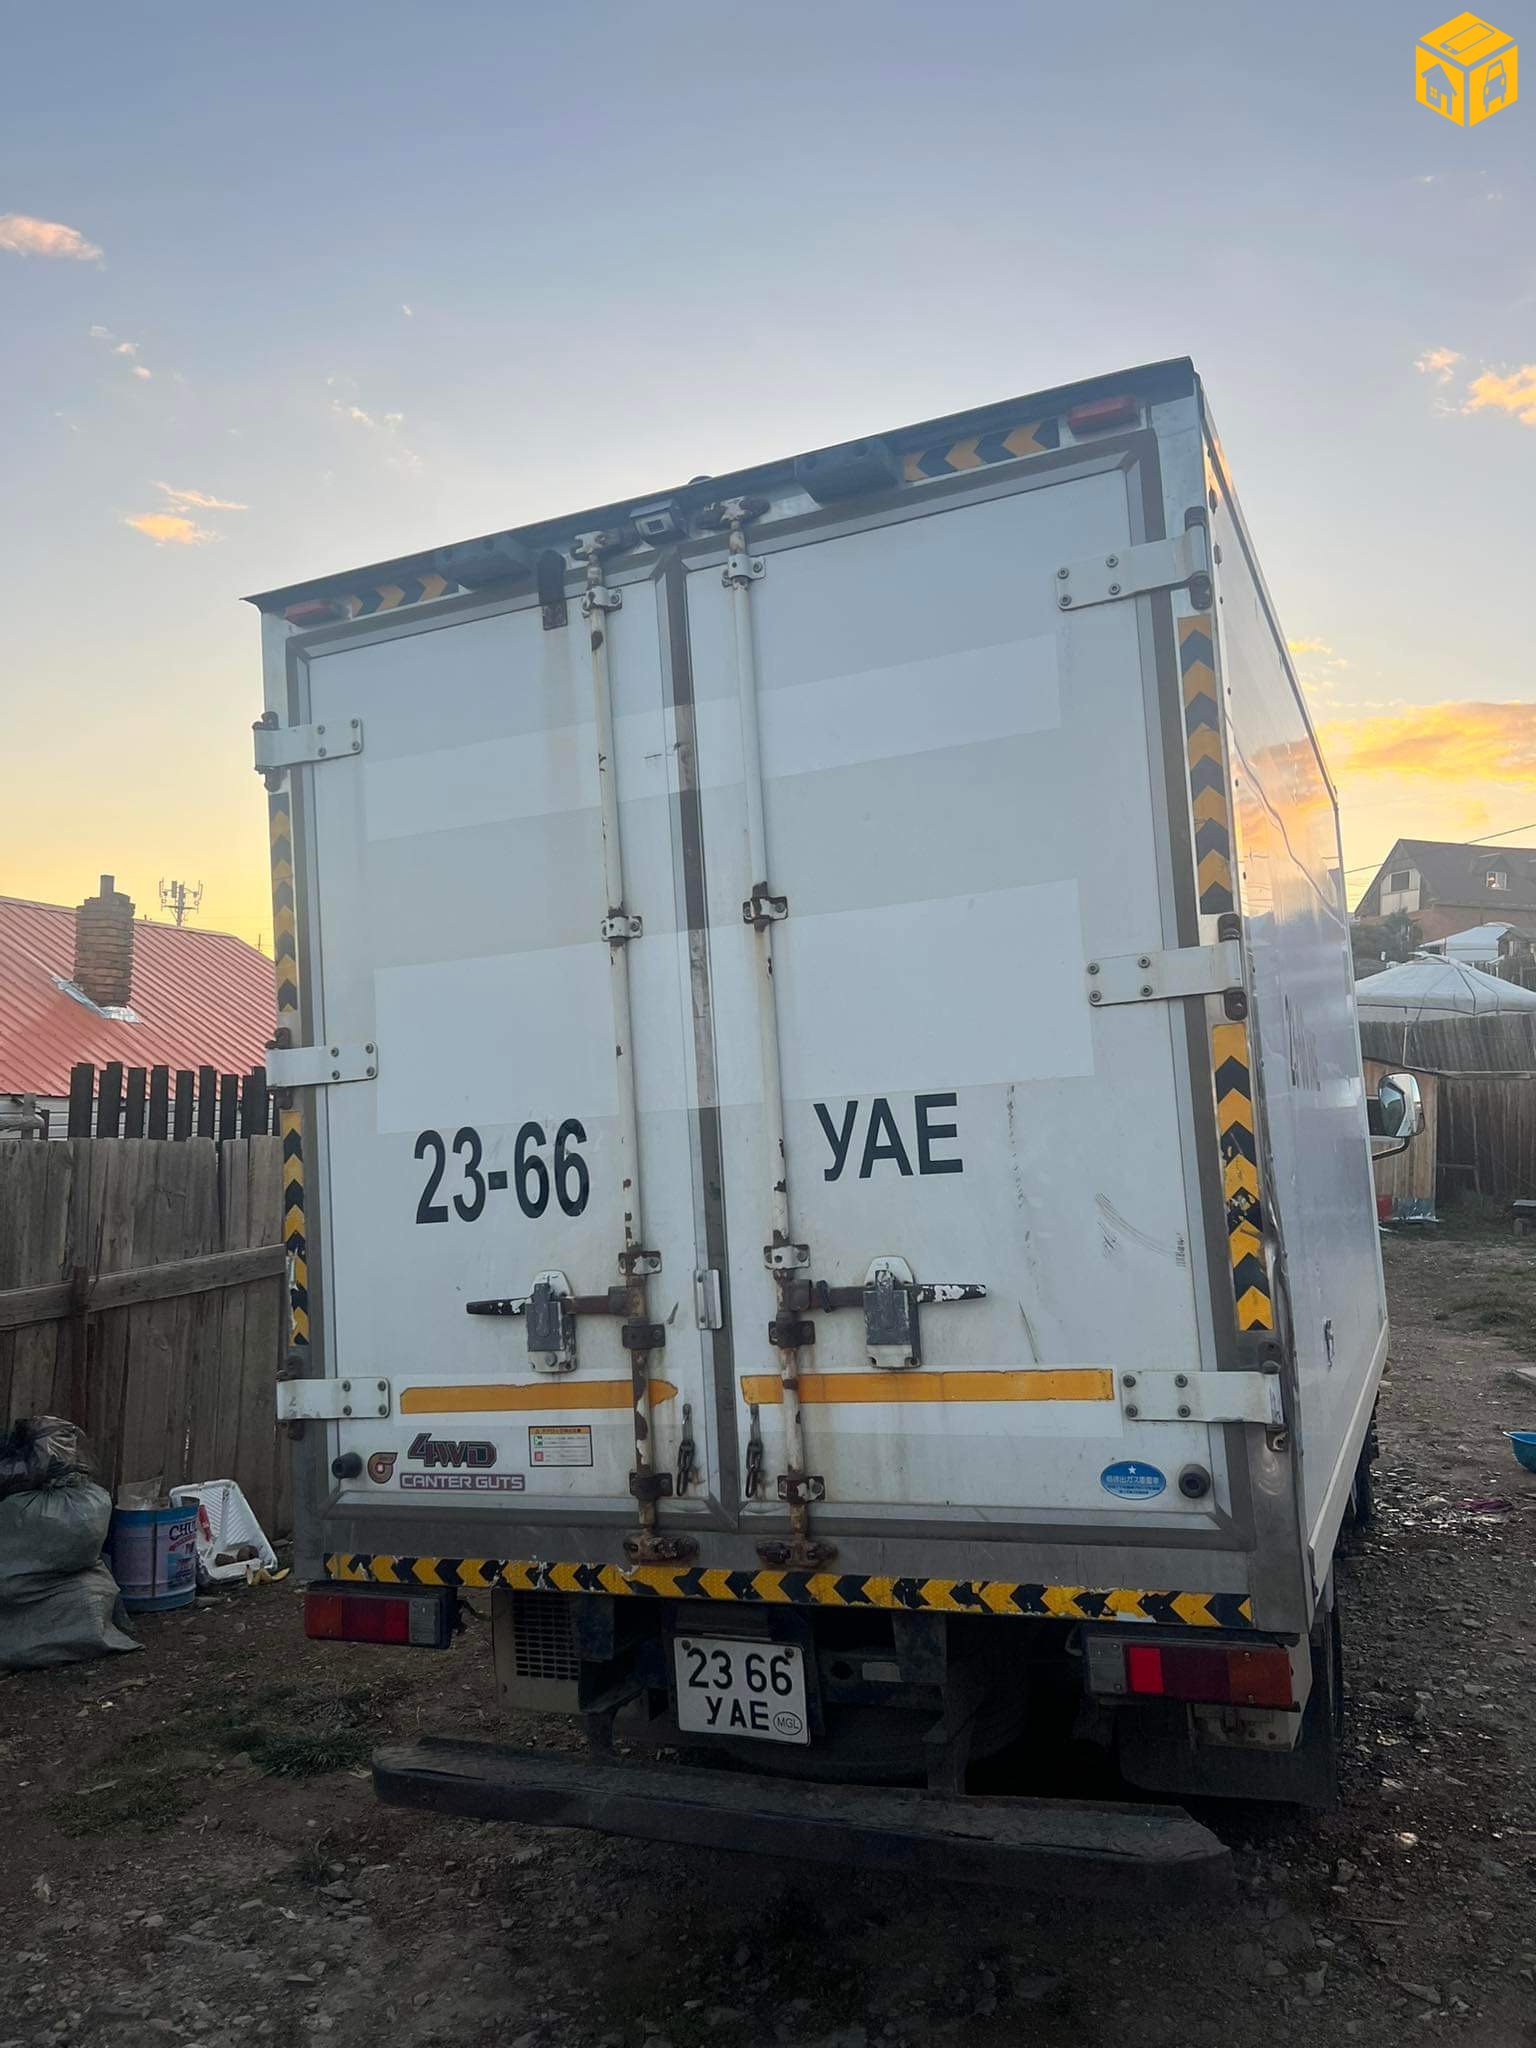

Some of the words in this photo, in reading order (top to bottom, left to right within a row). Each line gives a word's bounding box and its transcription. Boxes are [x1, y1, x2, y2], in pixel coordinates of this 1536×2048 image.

[414, 1118, 590, 1224] 23-66
[408, 1433, 498, 1468] 4WD
[401, 1475, 472, 1489] CANTER
[475, 1476, 523, 1489] GUTS
[687, 1647, 733, 1690] 23
[745, 1653, 792, 1696] 66
[776, 1718, 800, 1730] MGL
